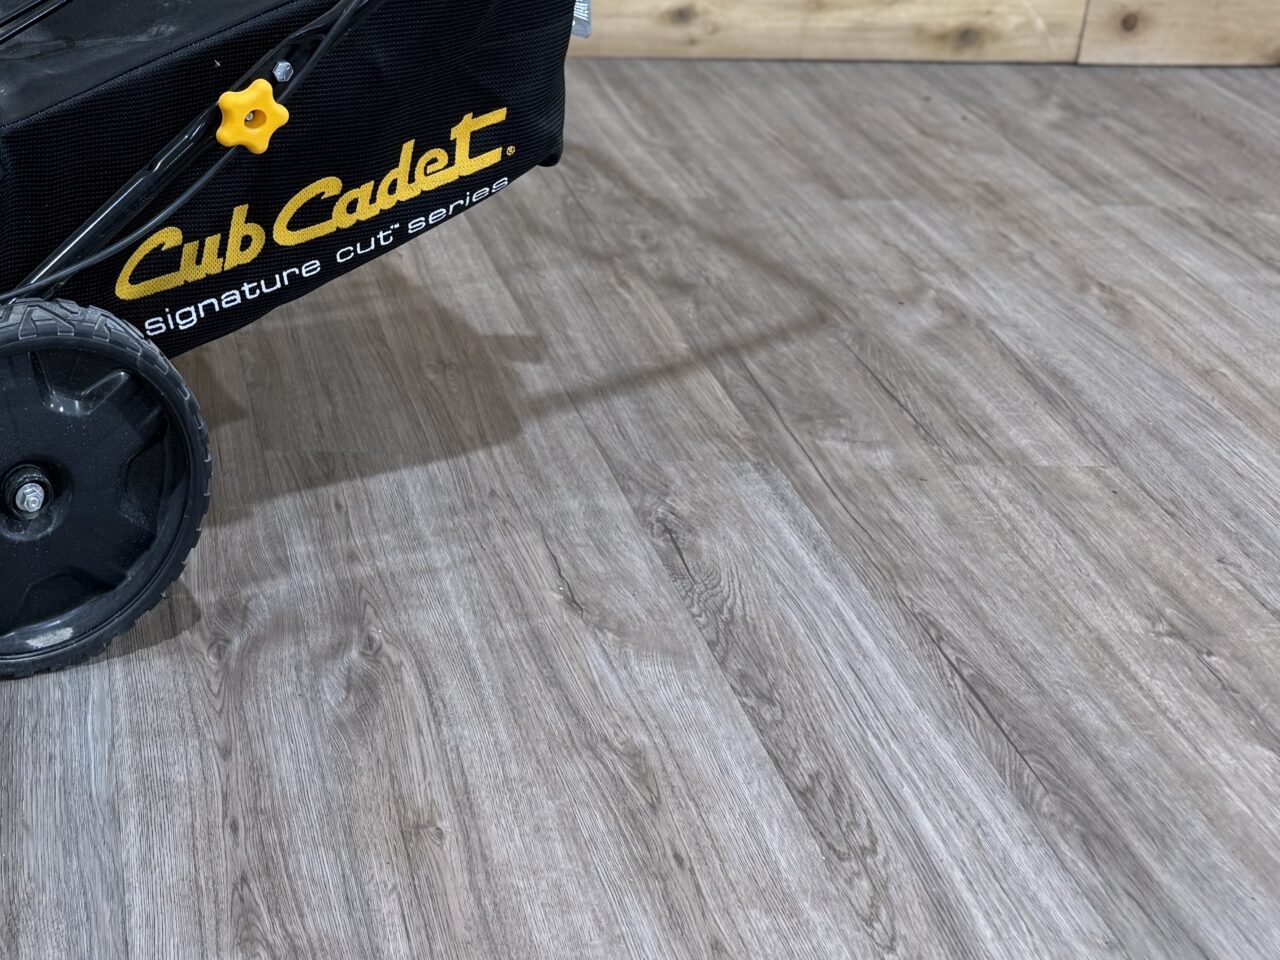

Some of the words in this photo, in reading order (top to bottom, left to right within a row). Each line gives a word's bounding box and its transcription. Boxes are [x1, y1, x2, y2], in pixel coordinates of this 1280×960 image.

[115, 204, 266, 300] Cub
[273, 107, 507, 246] Cadet
[144, 259, 321, 336] signature
[408, 177, 509, 234] series
